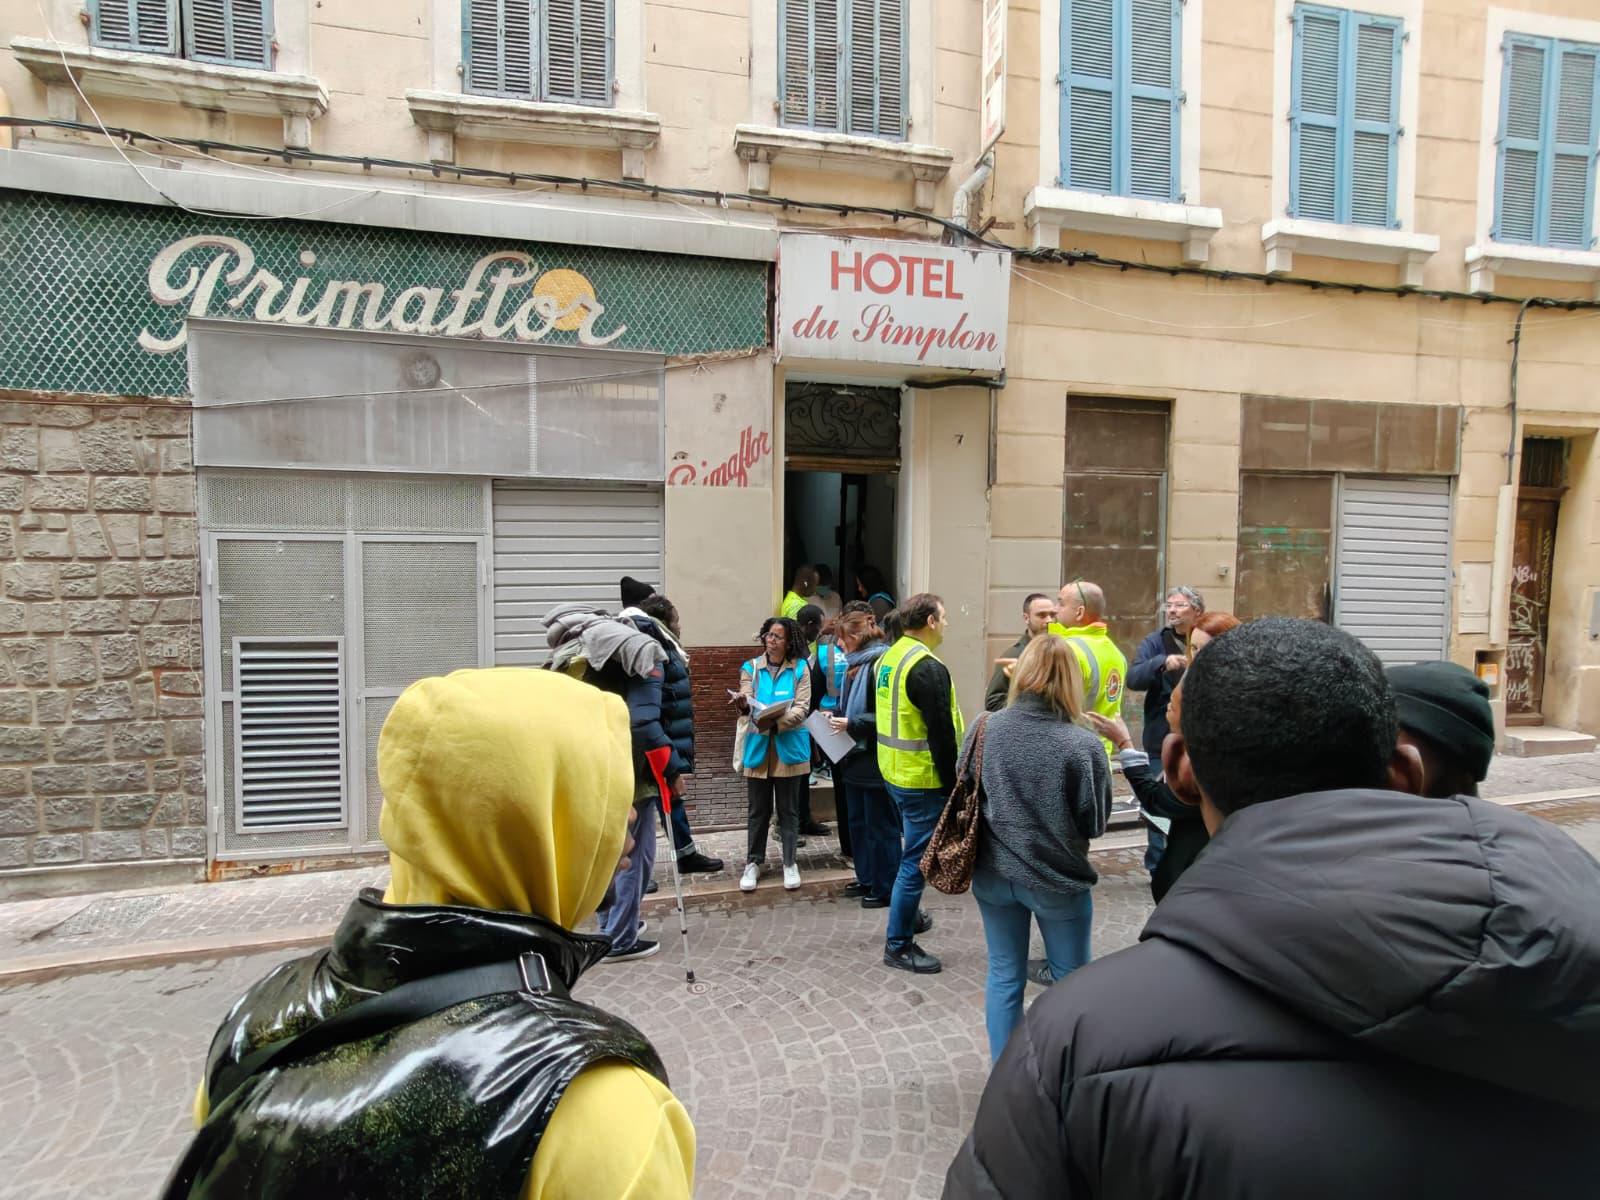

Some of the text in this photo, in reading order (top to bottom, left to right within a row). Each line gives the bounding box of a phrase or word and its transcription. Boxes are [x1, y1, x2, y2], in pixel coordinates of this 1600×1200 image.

[137, 234, 628, 353] Primaflor
[830, 250, 963, 300] HOTEL
[792, 303, 998, 360] du Simplon
[667, 424, 771, 488] Pimaflor
[953, 433, 964, 448] 7
